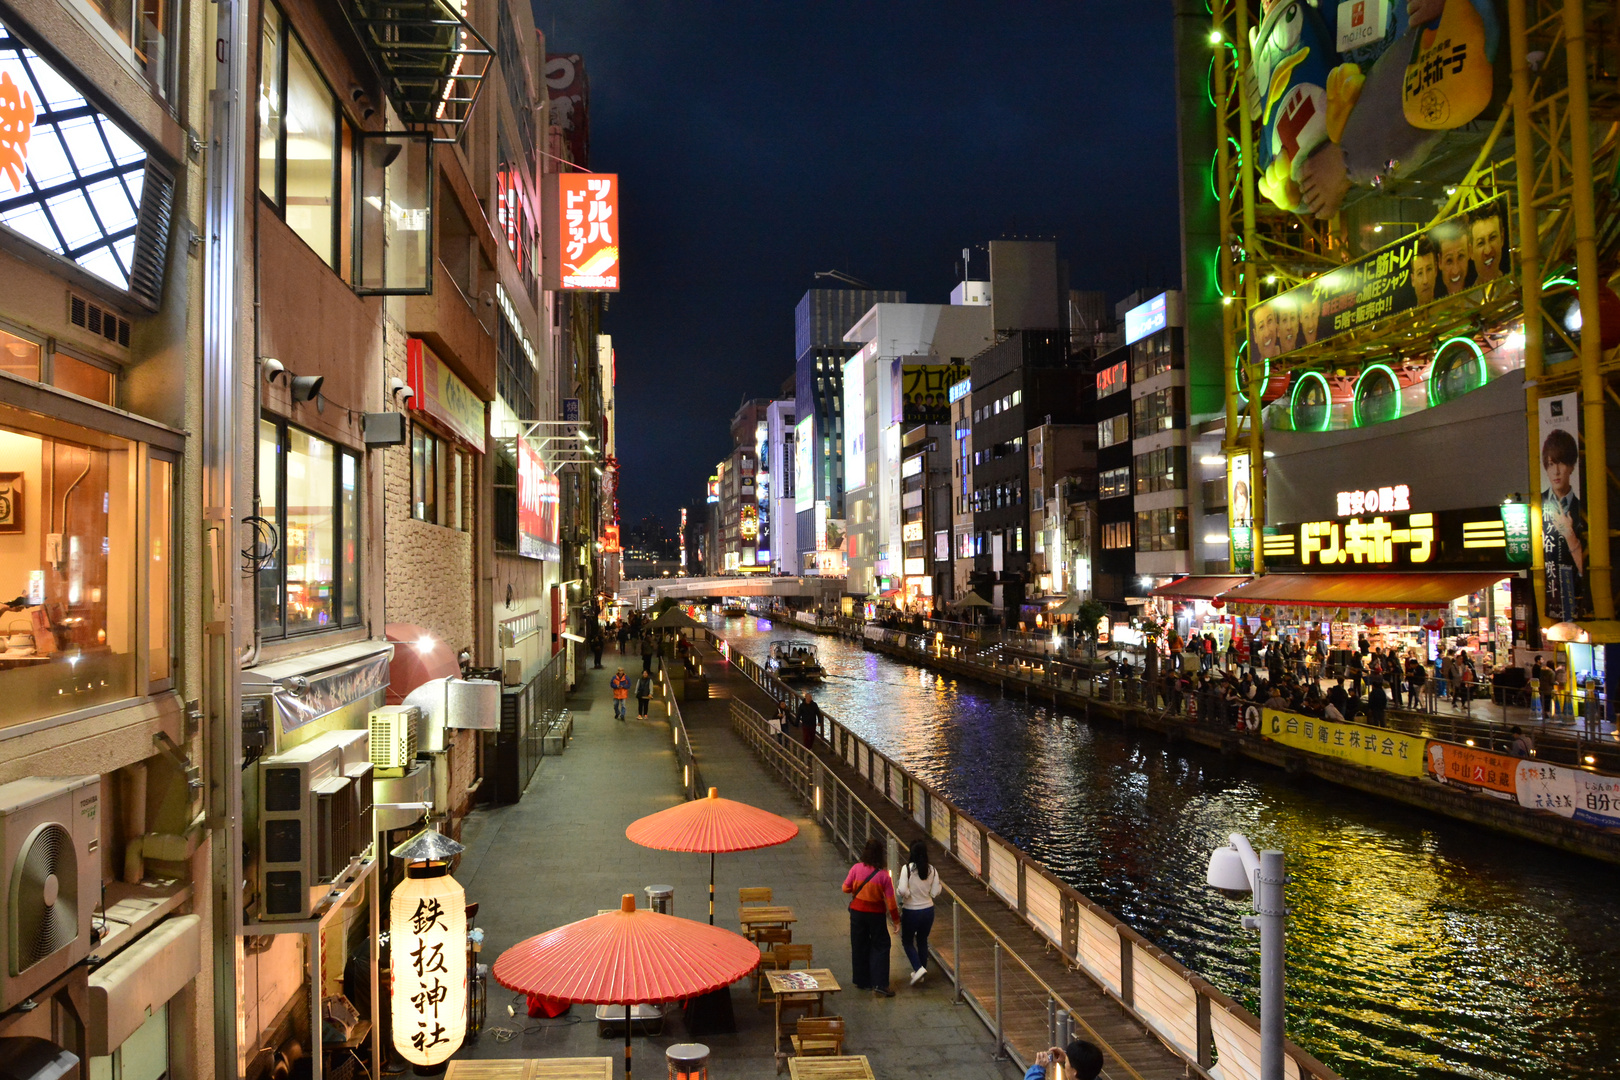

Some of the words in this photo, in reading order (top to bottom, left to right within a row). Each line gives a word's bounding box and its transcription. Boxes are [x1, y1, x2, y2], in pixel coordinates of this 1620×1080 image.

[566, 190, 587, 260] ドラッグ
[587, 179, 612, 244] ツルハ
[1286, 717, 1409, 760] 合同衛生株式会社
[408, 897, 450, 1052] 鉄板神社
